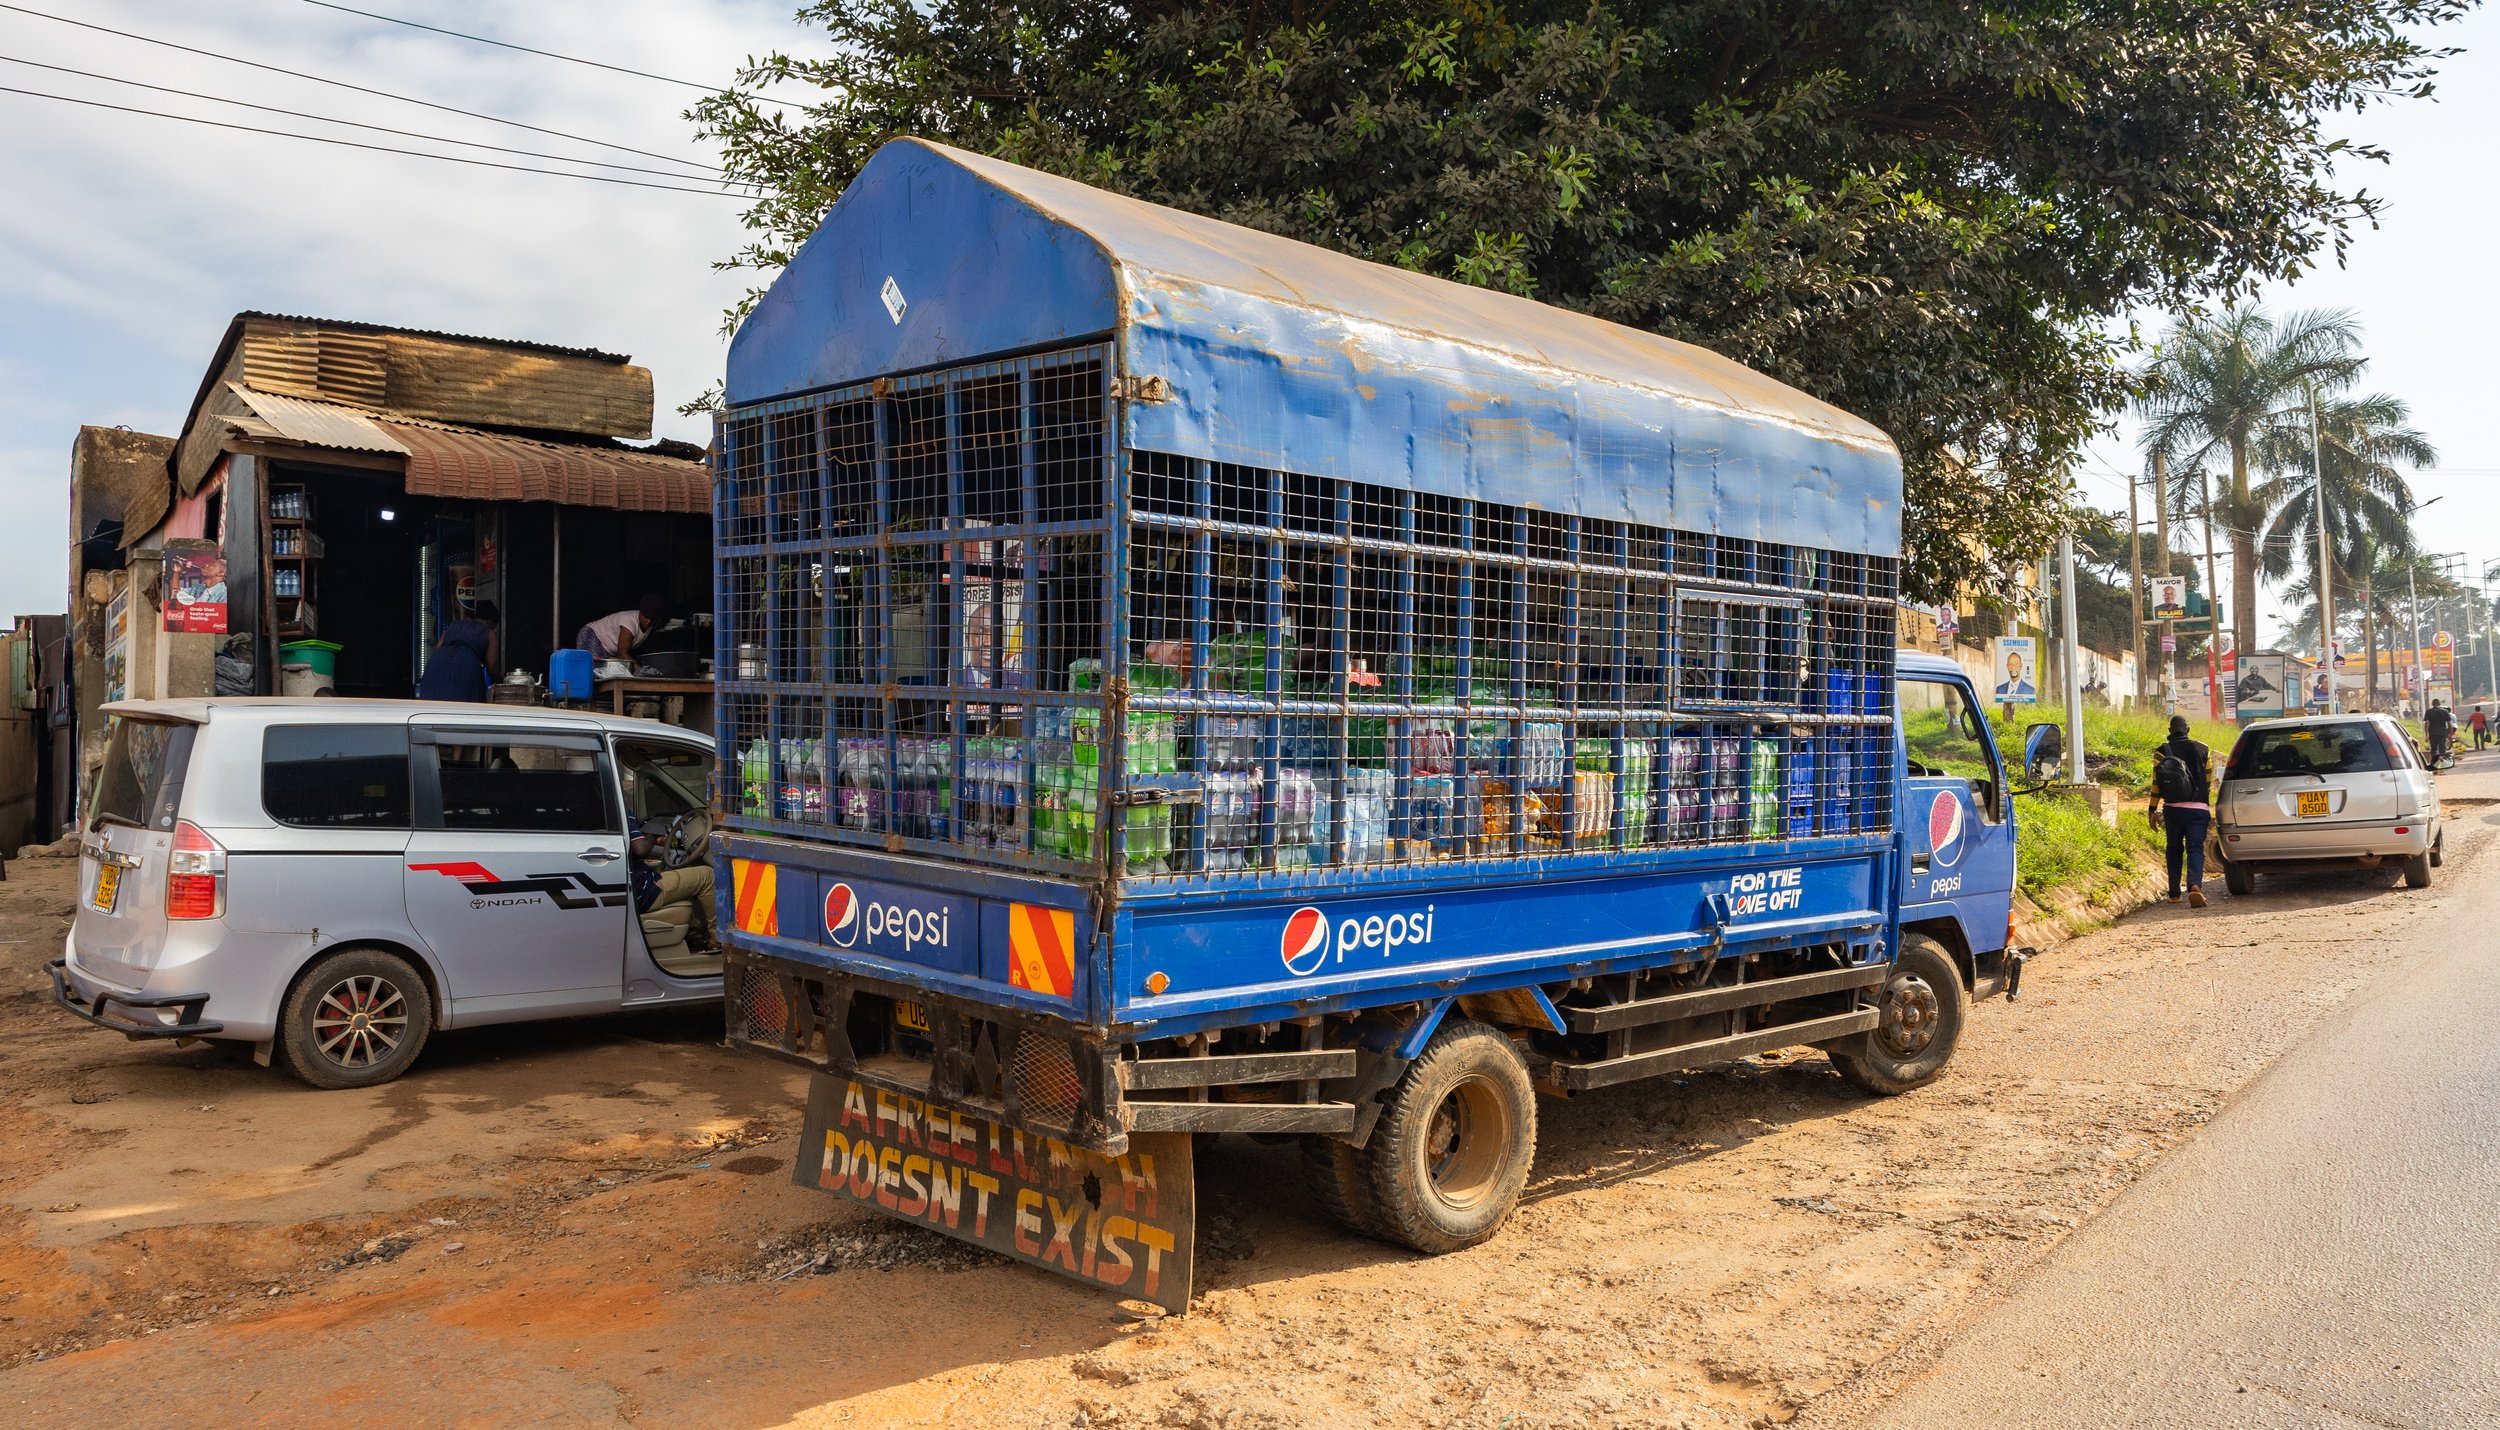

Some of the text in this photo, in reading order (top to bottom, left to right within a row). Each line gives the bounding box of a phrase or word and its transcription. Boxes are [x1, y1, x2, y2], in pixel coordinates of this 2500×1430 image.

[2306, 792, 2326, 802] UAY
[1729, 867, 1802, 894] FOR THE
[1931, 872, 1961, 899] pepsi
[487, 897, 542, 907] NOAH
[866, 900, 949, 952] pepsi
[1337, 904, 1435, 963] pepsi
[1012, 969, 1022, 986] R
[840, 1080, 871, 1133] A
[876, 1088, 977, 1166] FREE
[819, 1129, 1000, 1238] DOESN'T
[1015, 1188, 1175, 1298] EXIST
